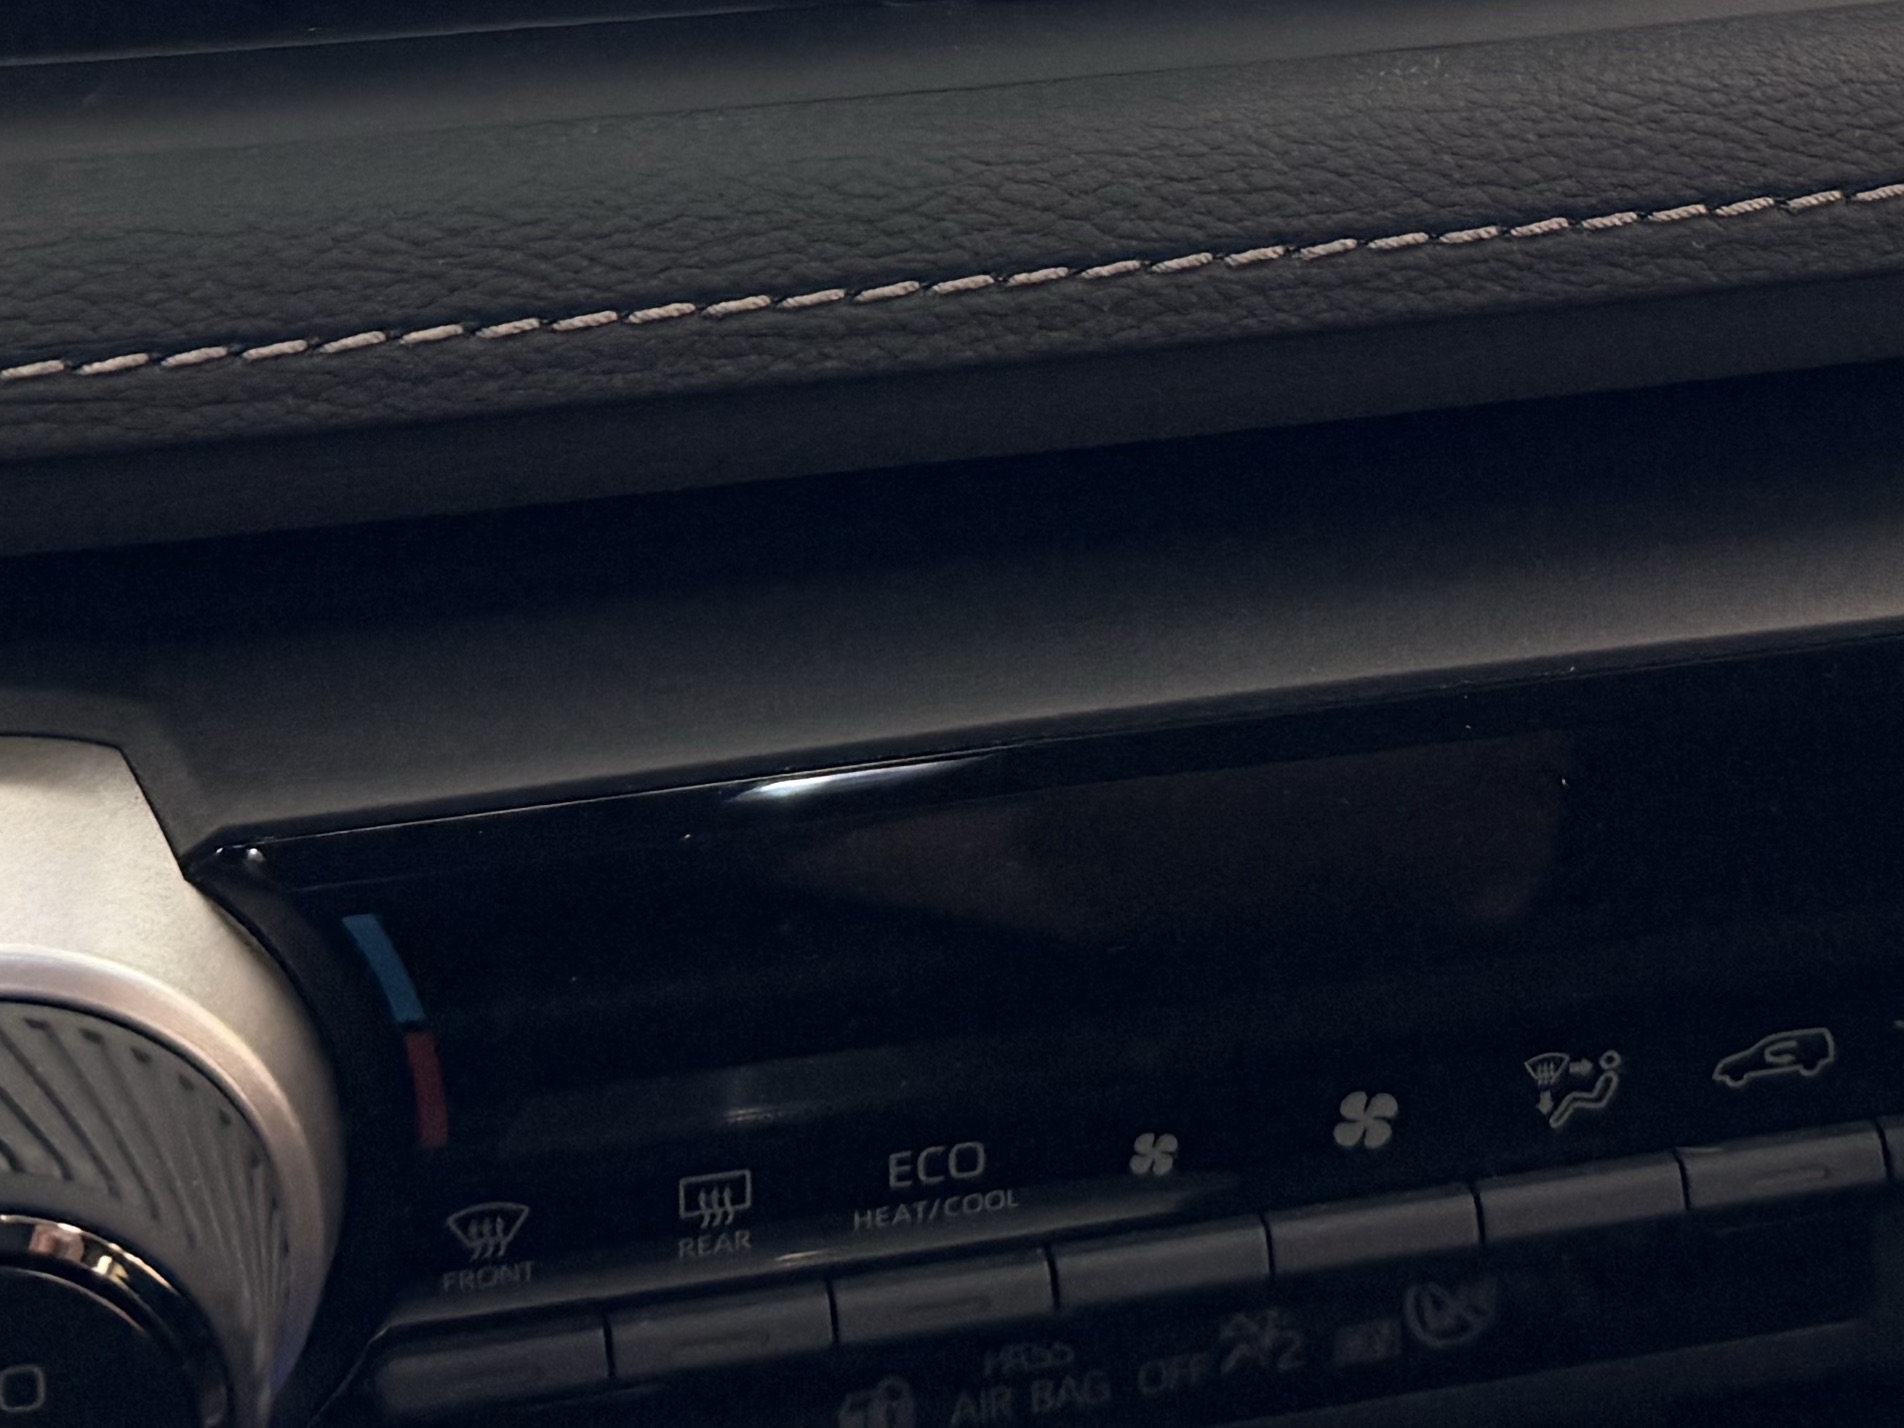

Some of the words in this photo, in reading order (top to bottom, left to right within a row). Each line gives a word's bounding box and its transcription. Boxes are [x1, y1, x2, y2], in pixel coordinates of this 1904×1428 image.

[887, 1142, 987, 1190] ECO
[853, 1187, 1021, 1234] HEAT/COOL
[677, 1229, 753, 1260] REAR
[441, 1259, 538, 1295] FRONT
[950, 1384, 1017, 1428] AIR
[1029, 1370, 1112, 1415] BAG
